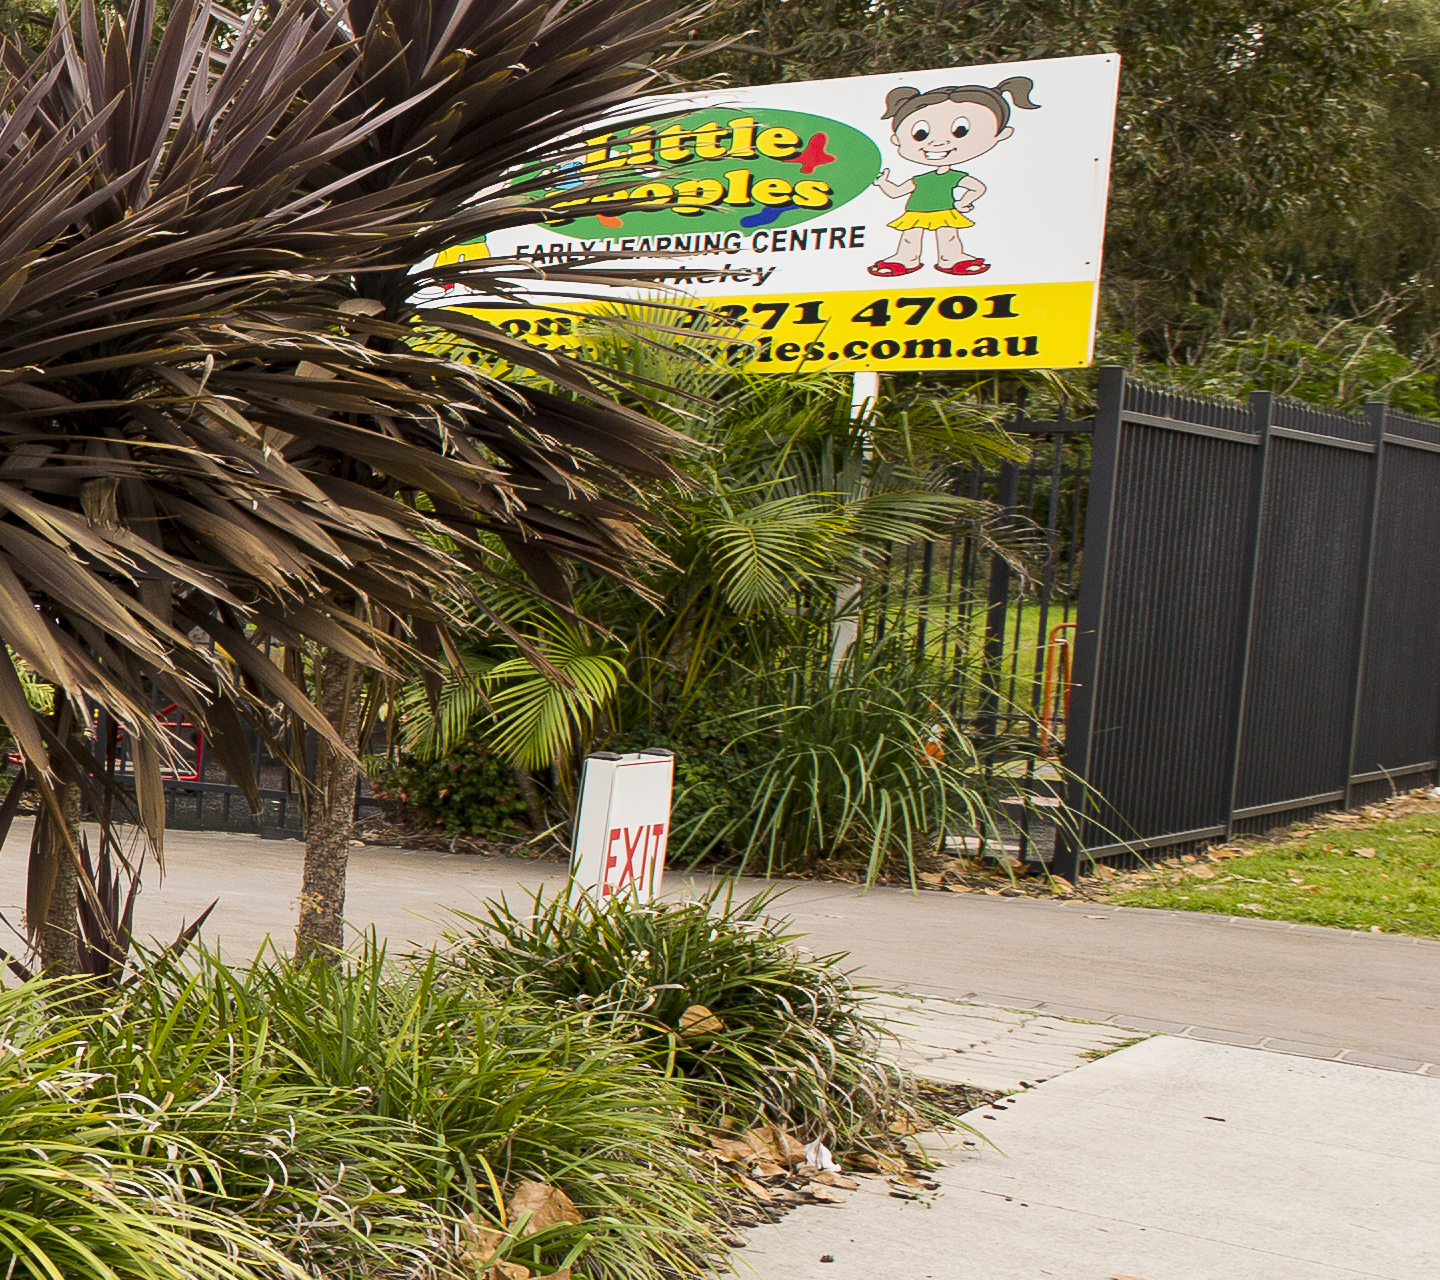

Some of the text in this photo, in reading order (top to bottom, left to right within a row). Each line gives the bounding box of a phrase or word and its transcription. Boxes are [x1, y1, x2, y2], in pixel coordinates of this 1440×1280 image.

[580, 117, 801, 174] Little
[544, 169, 833, 226] oples
[752, 226, 866, 253] CENTRE
[851, 294, 1020, 327] 4701
[602, 823, 664, 897] EXIT
